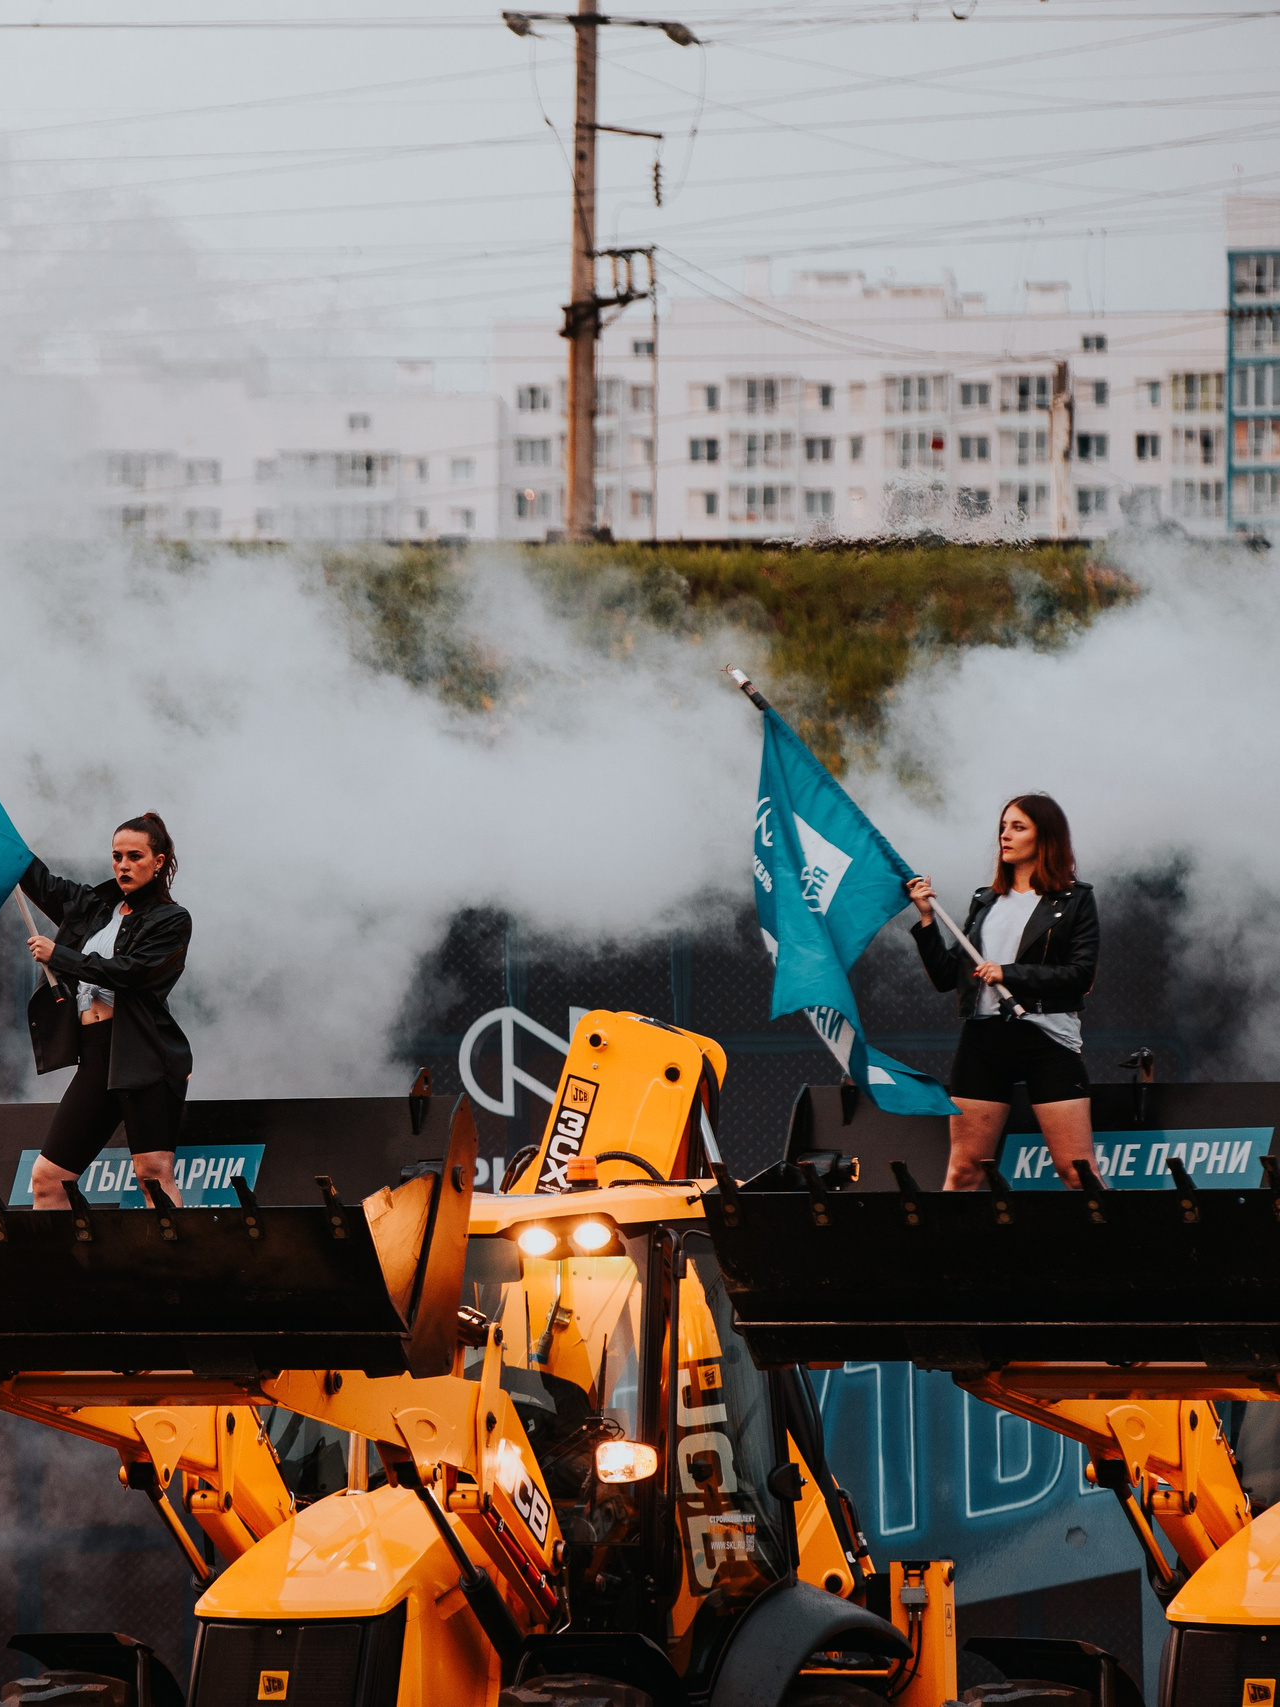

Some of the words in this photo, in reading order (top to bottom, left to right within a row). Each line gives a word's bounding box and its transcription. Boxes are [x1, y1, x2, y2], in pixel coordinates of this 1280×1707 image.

[573, 1087, 588, 1102] JCB
[1013, 1144, 1141, 1179] КРЫЕ
[173, 1157, 246, 1191] АРНИ
[265, 1676, 283, 1693] JCB
[1250, 1685, 1270, 1701] JCB
